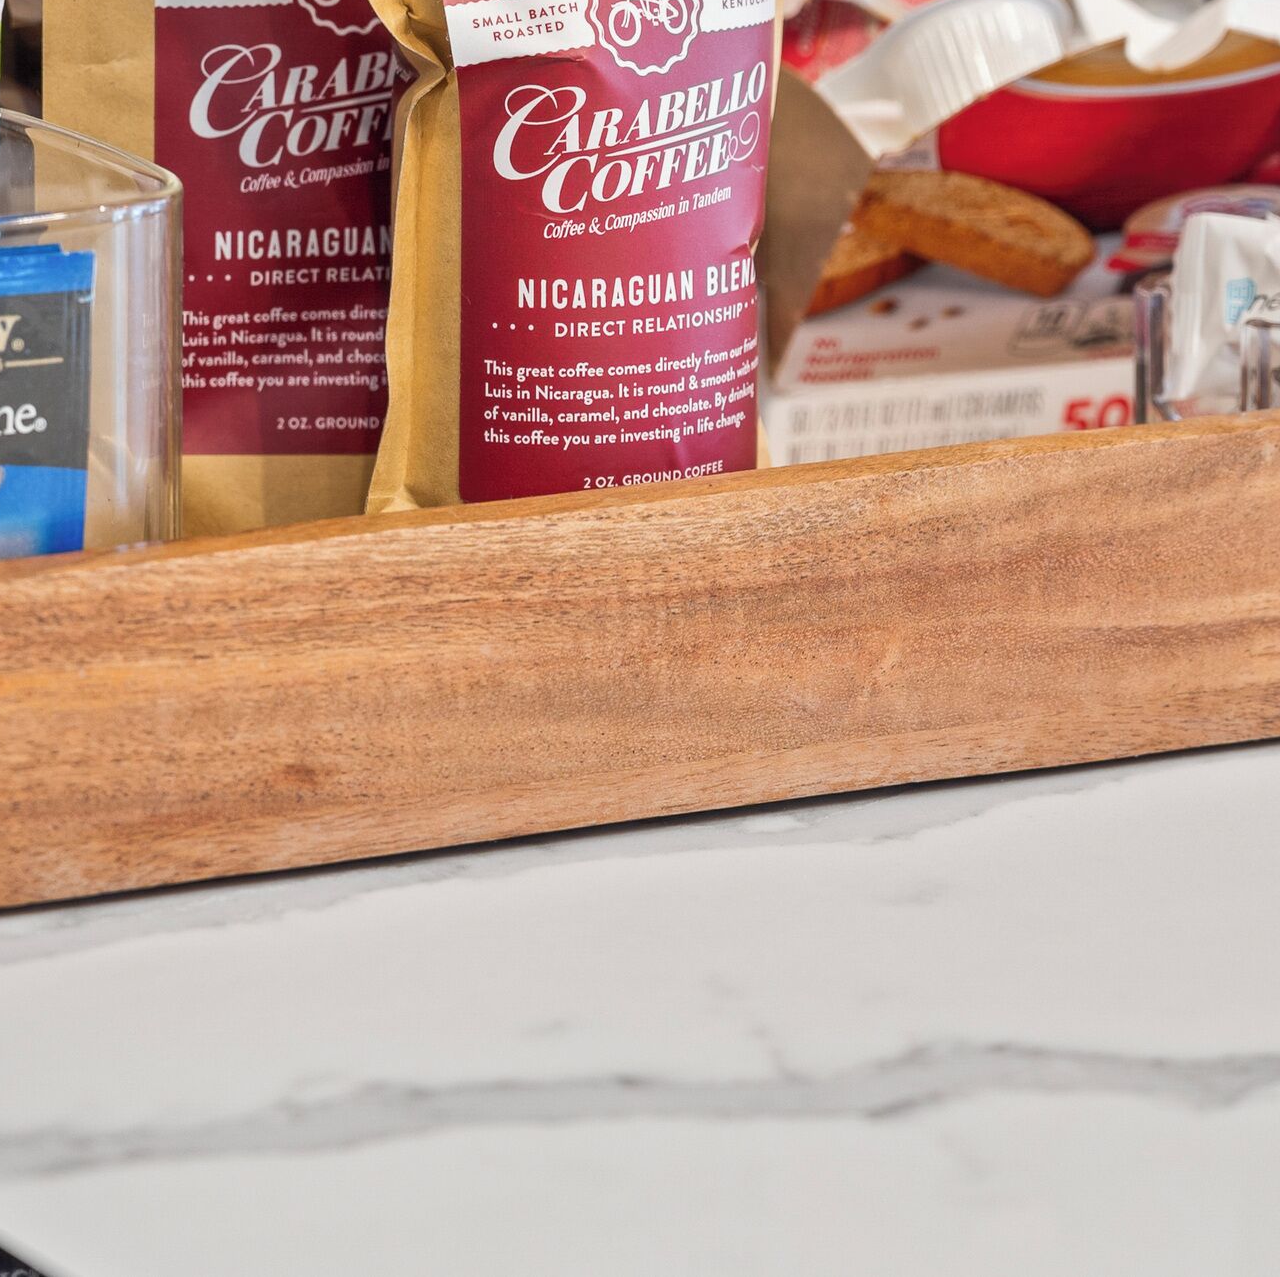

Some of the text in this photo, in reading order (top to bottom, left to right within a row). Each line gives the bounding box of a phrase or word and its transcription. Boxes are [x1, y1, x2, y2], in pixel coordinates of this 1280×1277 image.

[472, 1, 579, 30] SMALL BATCH
[493, 20, 565, 42] ROASTED
[238, 102, 392, 168] COFF
[493, 61, 767, 181] CARABELLO
[240, 173, 282, 194] Coffee
[284, 171, 300, 190] &
[299, 158, 375, 186] Compassion
[541, 125, 742, 214] COFFEE
[543, 185, 732, 239] Coffee & Compassion in Tandem
[214, 226, 393, 261] NICARAGUAN
[250, 268, 320, 286] DIRECT
[518, 257, 756, 310] NICARAGUAN BLEND
[182, 310, 210, 326] This
[213, 312, 251, 330] great
[254, 307, 298, 323] coffee
[301, 309, 347, 322] comes
[182, 324, 384, 348] Luis in Nicaragua. It is round
[554, 302, 743, 338] DIRECT RELATIONSHIP
[181, 352, 196, 368] of
[198, 351, 249, 368] vanilla,
[252, 348, 314, 367] caramel,
[316, 350, 343, 365] and
[484, 359, 513, 377] This
[516, 365, 554, 382] great
[558, 362, 604, 378] coffee
[608, 360, 651, 376] comes
[655, 352, 702, 374] directly
[704, 349, 728, 365] from
[730, 344, 743, 359] our
[181, 373, 207, 388] this
[209, 371, 254, 388] coffee
[257, 375, 284, 392] you
[287, 374, 310, 387] are
[312, 371, 379, 391] investing
[484, 382, 513, 399] Luis
[517, 385, 530, 399] in
[535, 385, 614, 405] Nicaragua.
[618, 383, 629, 398] It
[633, 383, 644, 397] is
[647, 377, 685, 397] round
[688, 375, 698, 390] &
[701, 366, 735, 388] smooth
[737, 360, 751, 378] with
[484, 382, 755, 426] of vanilla, caramel, and chocolate. By drinking
[1063, 393, 1134, 431] 50
[276, 417, 286, 430] 2
[288, 416, 312, 430] OZ.
[314, 415, 380, 430] GROUND
[484, 410, 746, 451] this coffee you are investing in life change.
[583, 459, 724, 489] 2 OZ. GROUND COFFEE
